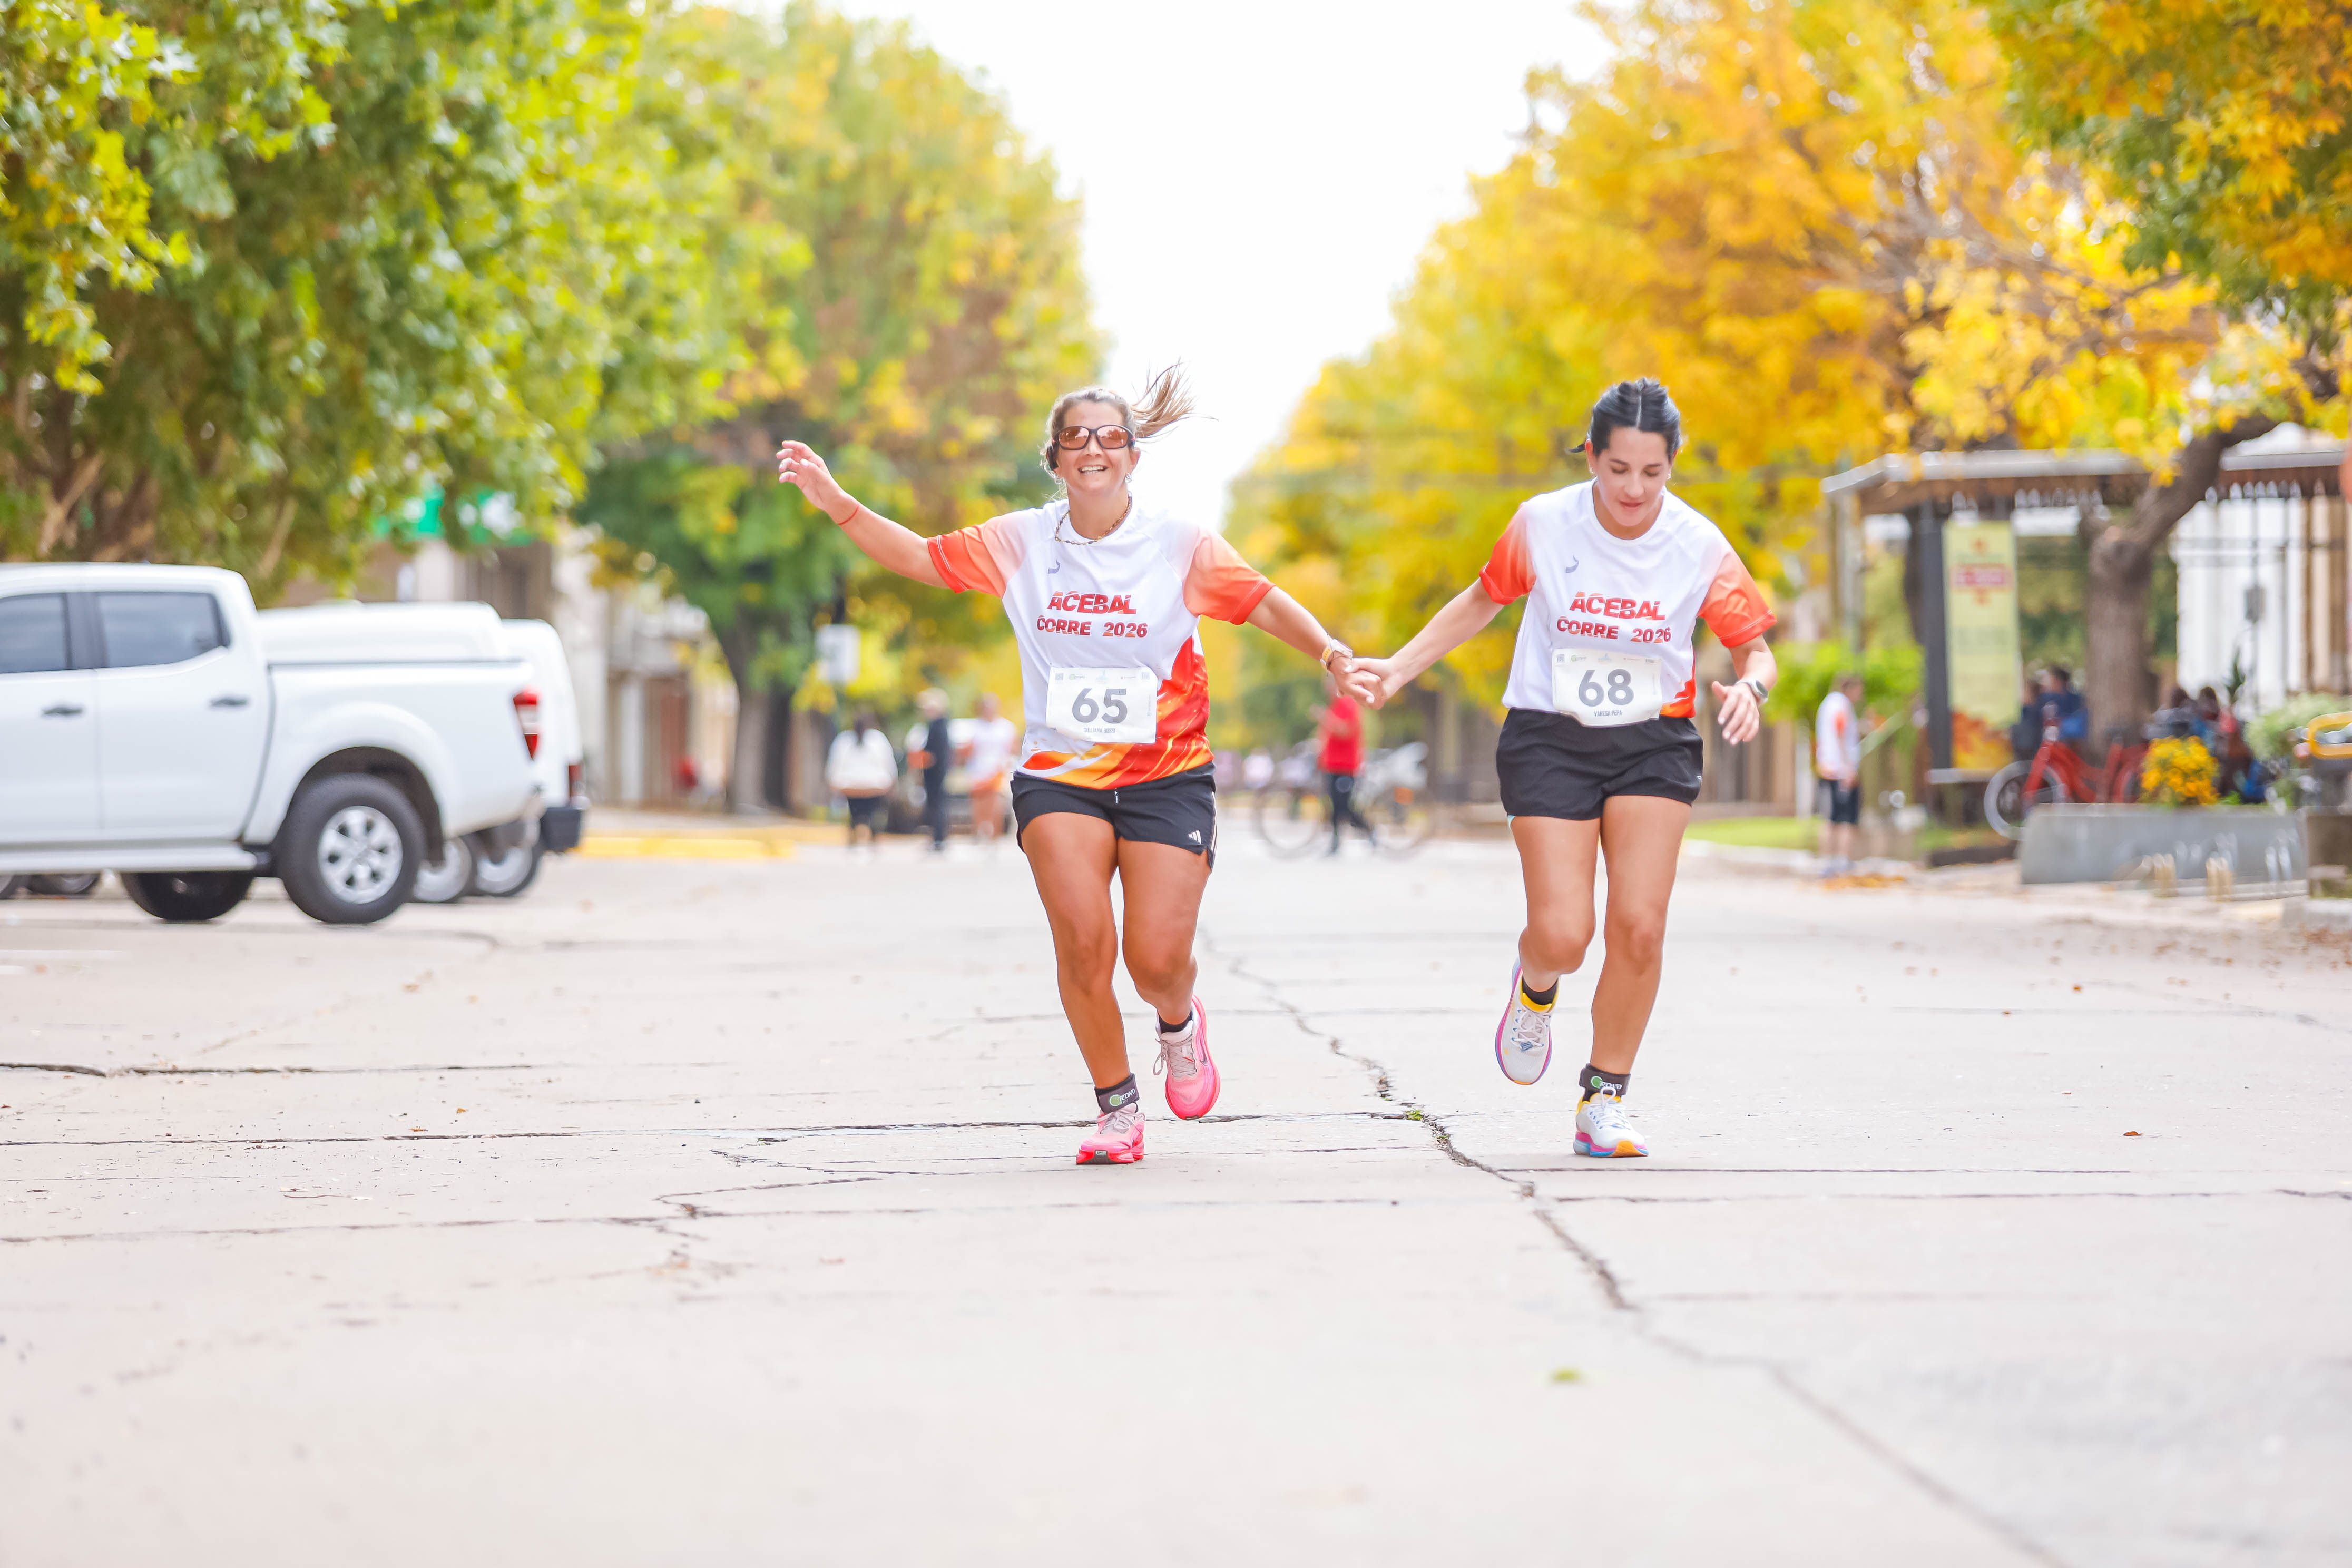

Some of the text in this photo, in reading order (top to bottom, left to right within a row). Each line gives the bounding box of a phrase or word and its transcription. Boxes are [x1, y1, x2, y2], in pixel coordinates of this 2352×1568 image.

[1047, 591, 1136, 614] ACEBAL
[1569, 591, 1665, 620] ACEBAL
[1037, 615, 1148, 638] CORRE 2026
[1557, 616, 1671, 643] CORRE 2026
[1579, 669, 1634, 707] 68
[1072, 688, 1128, 724] 65
